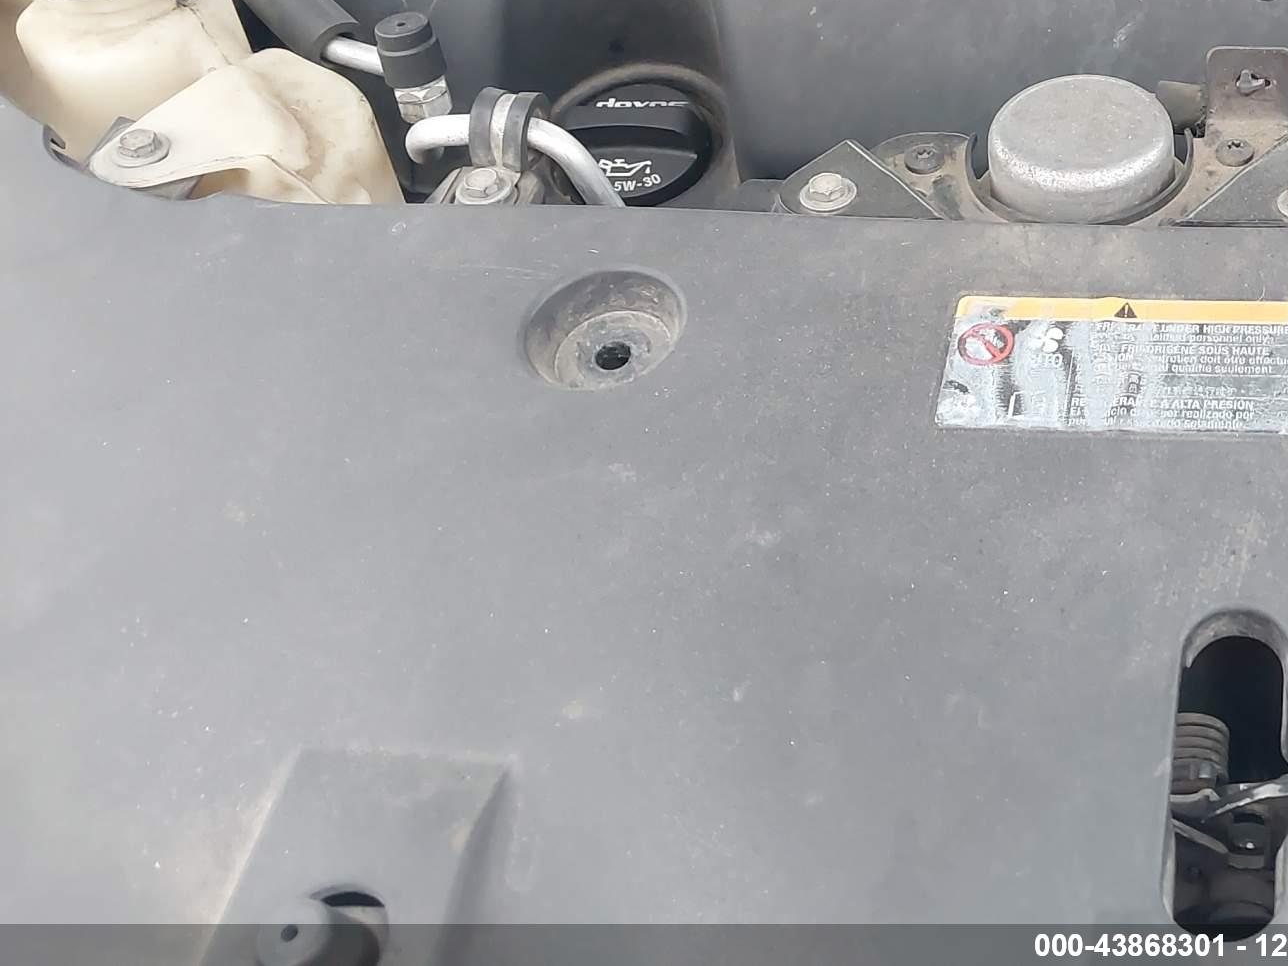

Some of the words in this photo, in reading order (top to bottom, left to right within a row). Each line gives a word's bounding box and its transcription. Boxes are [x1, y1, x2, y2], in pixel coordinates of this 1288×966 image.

[613, 173, 662, 192] 5W-30
[1202, 324, 1231, 334] HIGH
[1198, 345, 1230, 355] SOUS
[1231, 345, 1271, 356] HAUTE
[1213, 365, 1273, 375] seulement
